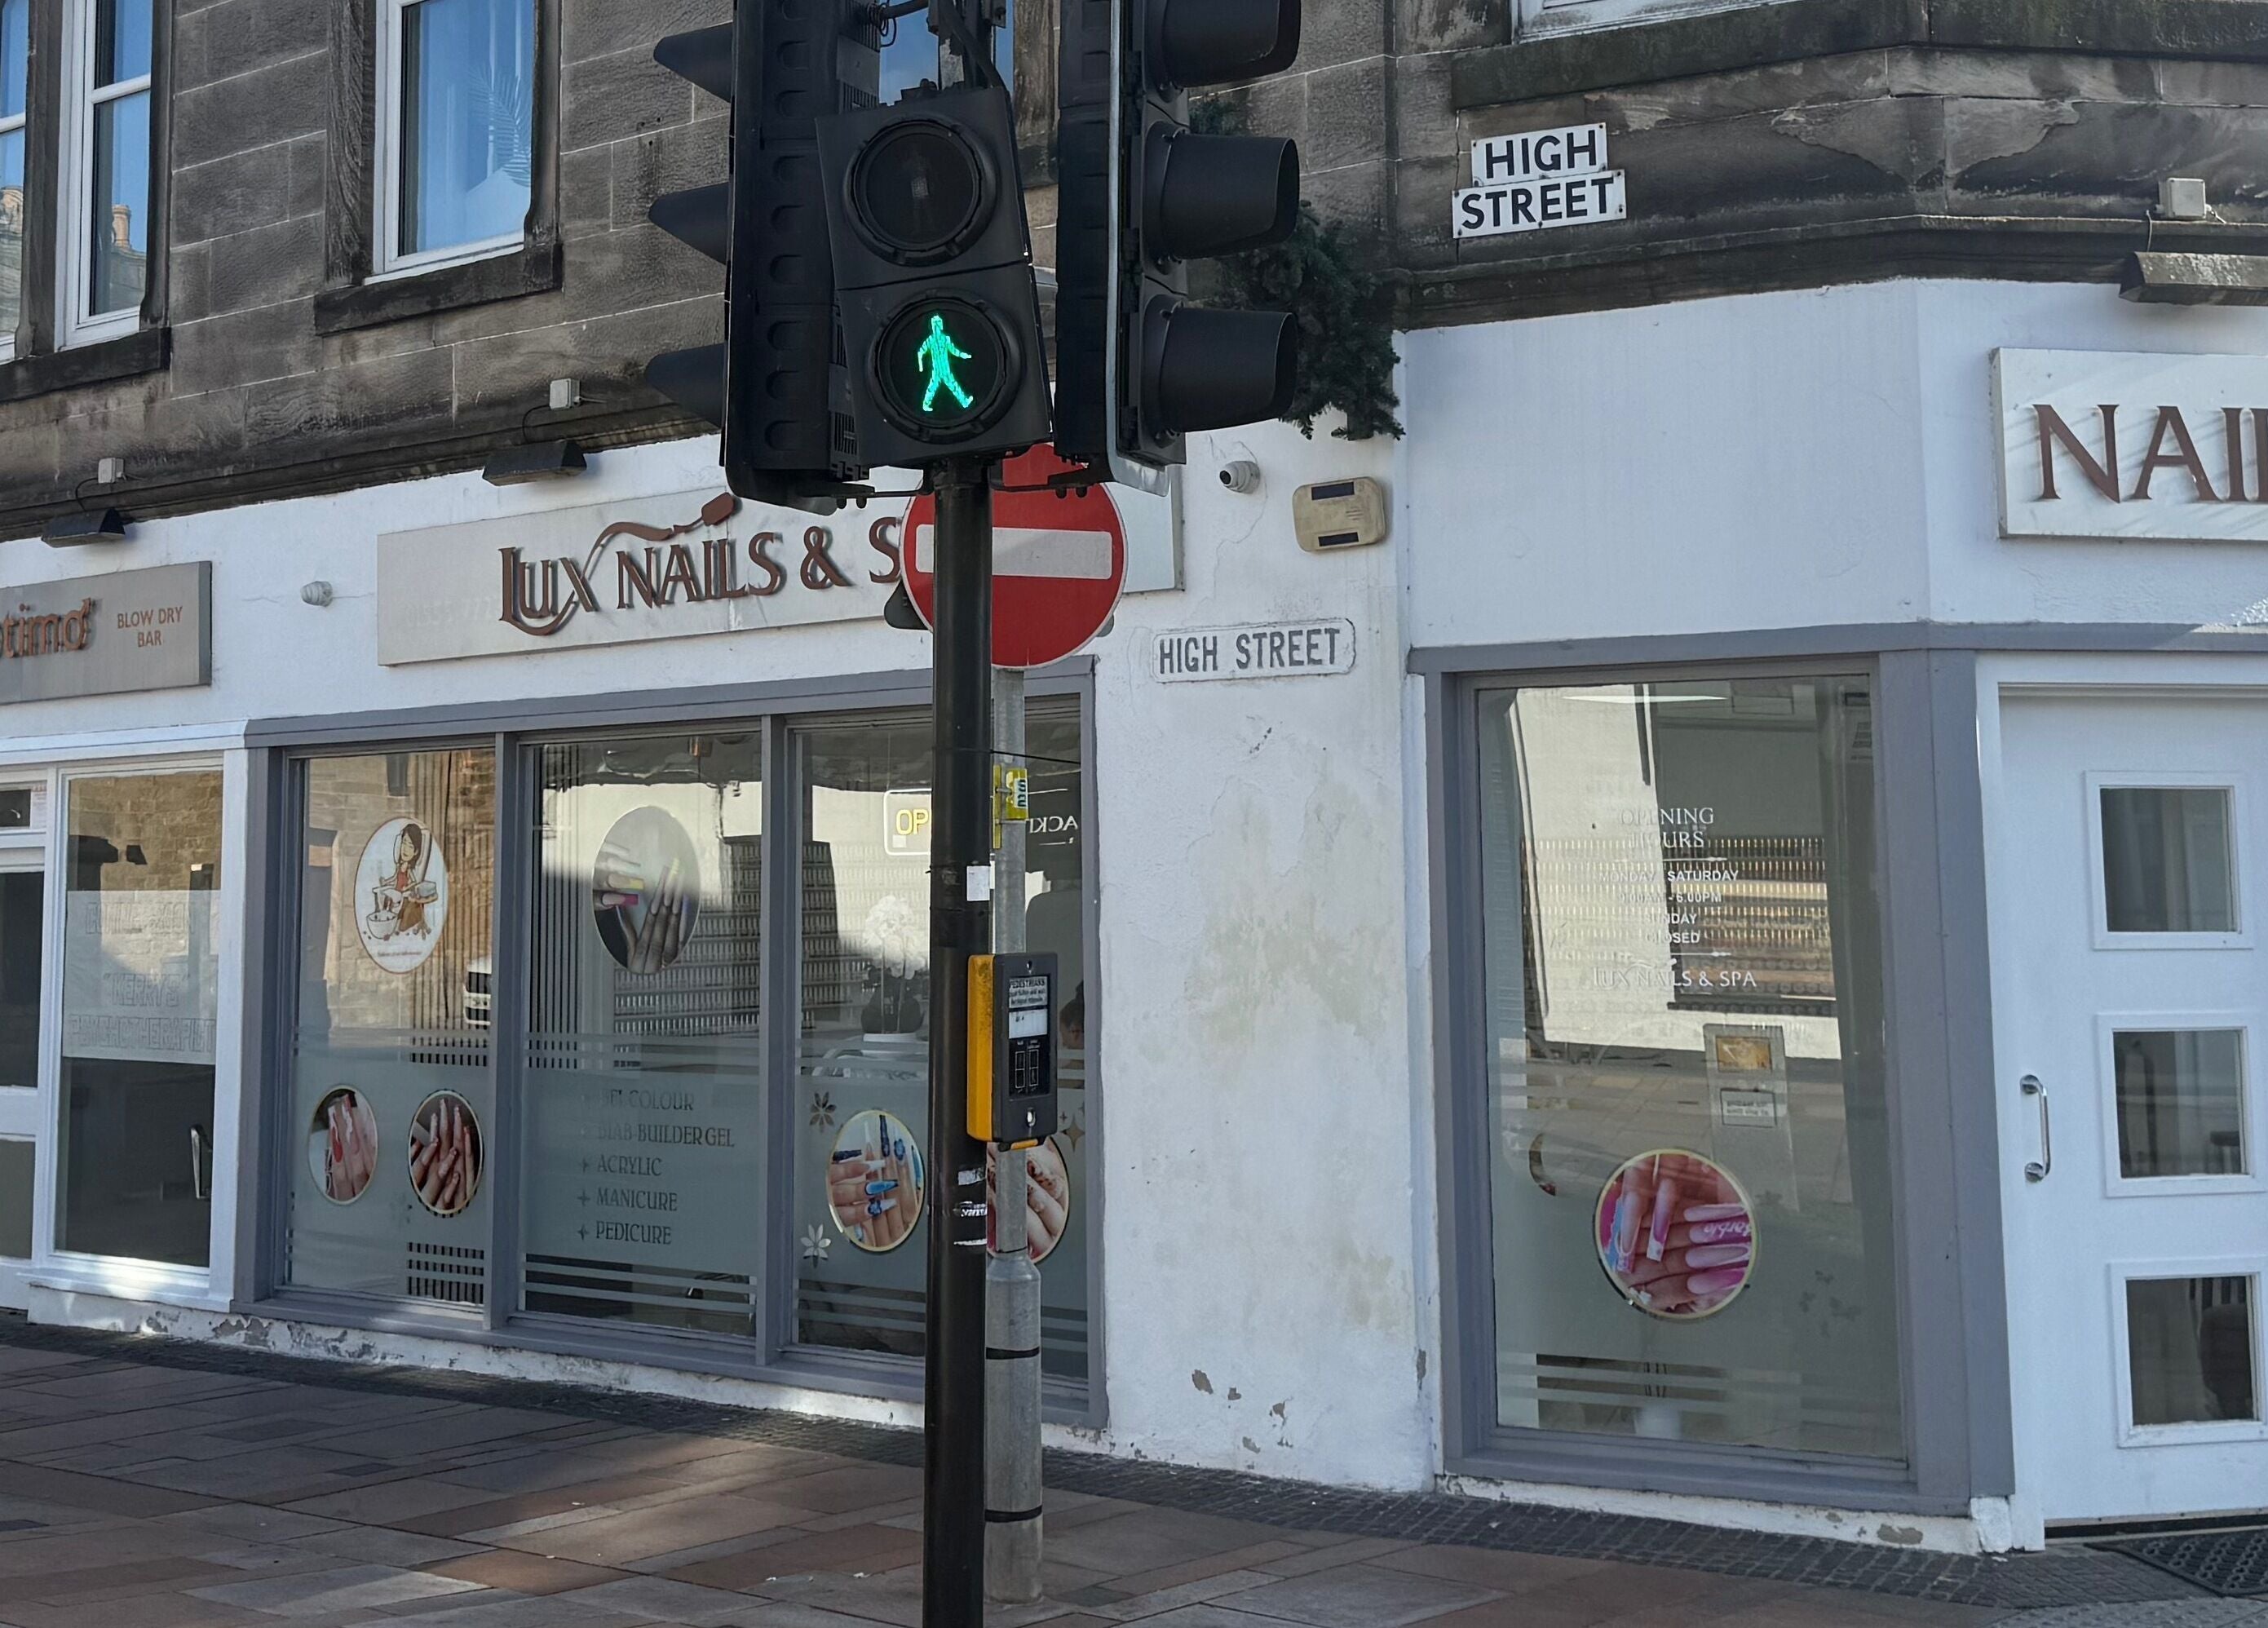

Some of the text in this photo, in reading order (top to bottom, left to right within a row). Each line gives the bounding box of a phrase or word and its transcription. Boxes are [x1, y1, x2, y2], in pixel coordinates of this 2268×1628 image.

[1485, 129, 1597, 179] HIGH
[1461, 176, 1614, 230] STREET
[616, 532, 783, 609] NAILS
[800, 525, 854, 591] &
[117, 606, 183, 629] BLOW DRY
[137, 630, 162, 648] BAR
[1159, 628, 1340, 675] HIGH STREET
[1667, 870, 1739, 881] SATURDAY
[1699, 971, 1714, 987] &
[1719, 970, 1757, 987] SPA
[705, 1126, 736, 1148] GEL
[597, 1154, 663, 1176] ACRYLIC
[596, 1187, 678, 1212] MANICURE
[595, 1220, 672, 1245] PEDICURE
